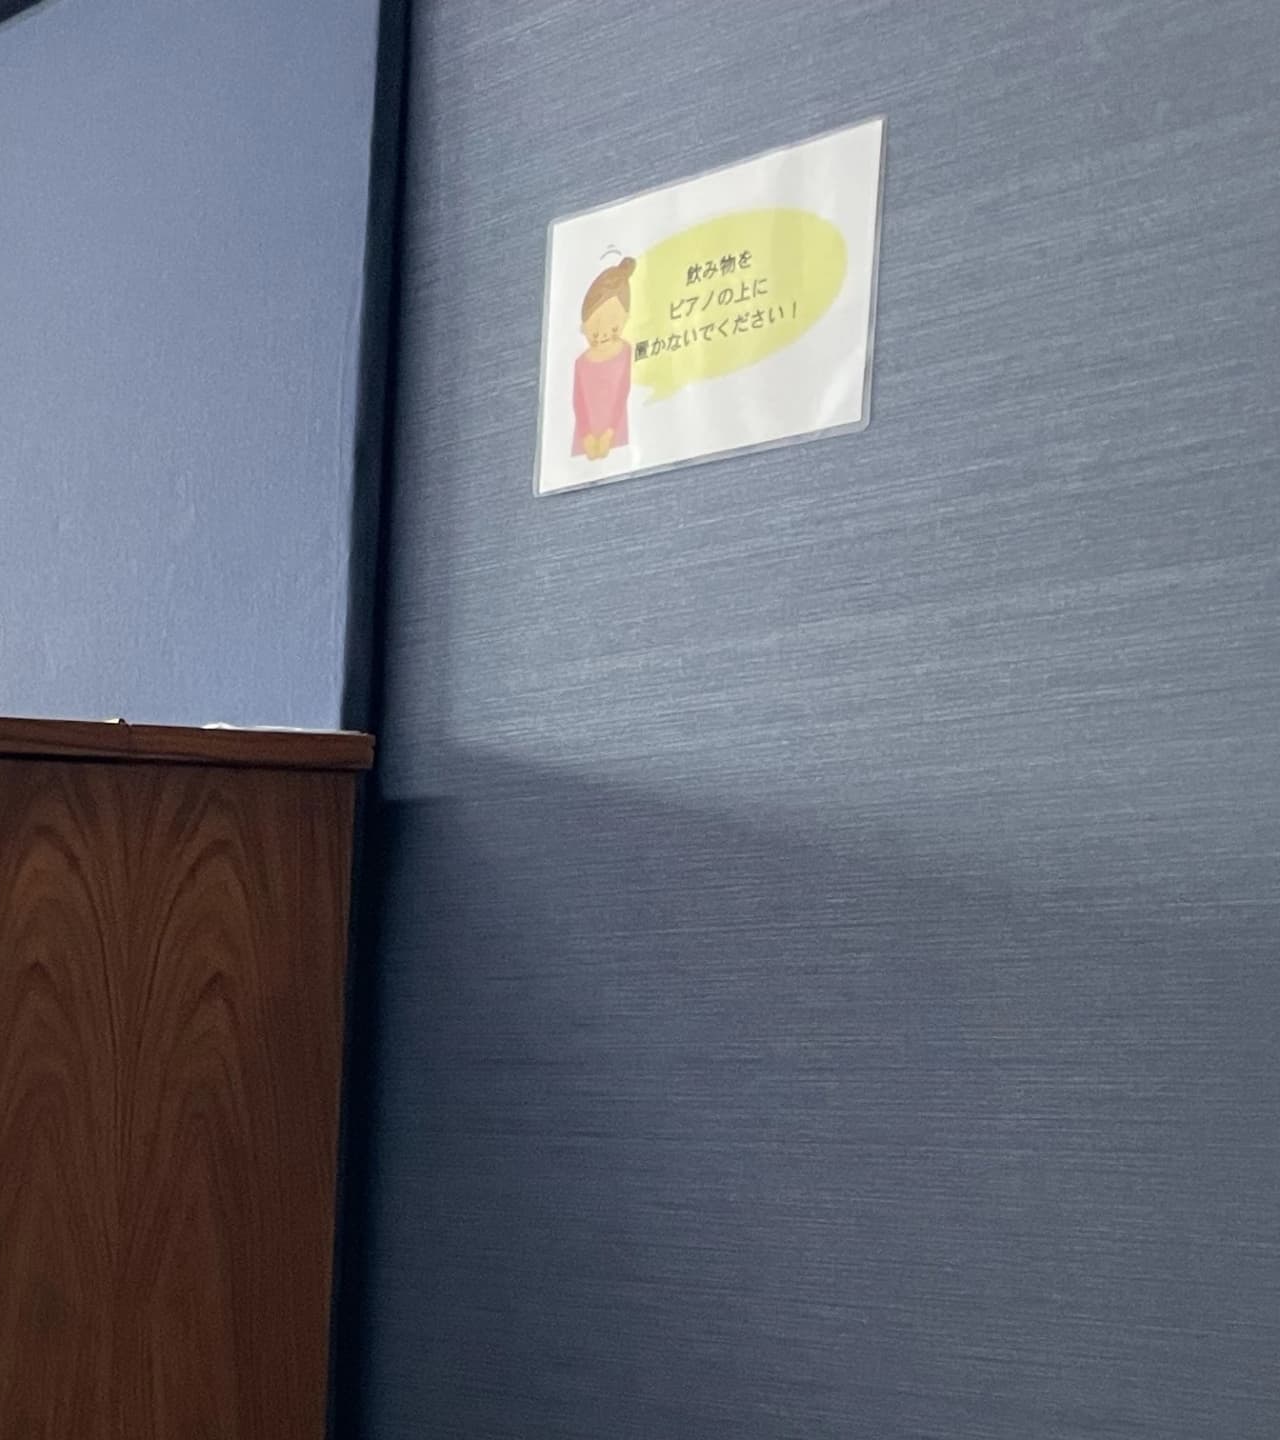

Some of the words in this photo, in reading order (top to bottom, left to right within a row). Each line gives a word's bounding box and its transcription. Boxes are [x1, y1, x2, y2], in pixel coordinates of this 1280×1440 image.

[686, 250, 752, 286] 飲み物を
[669, 278, 768, 320] ピアノの上に
